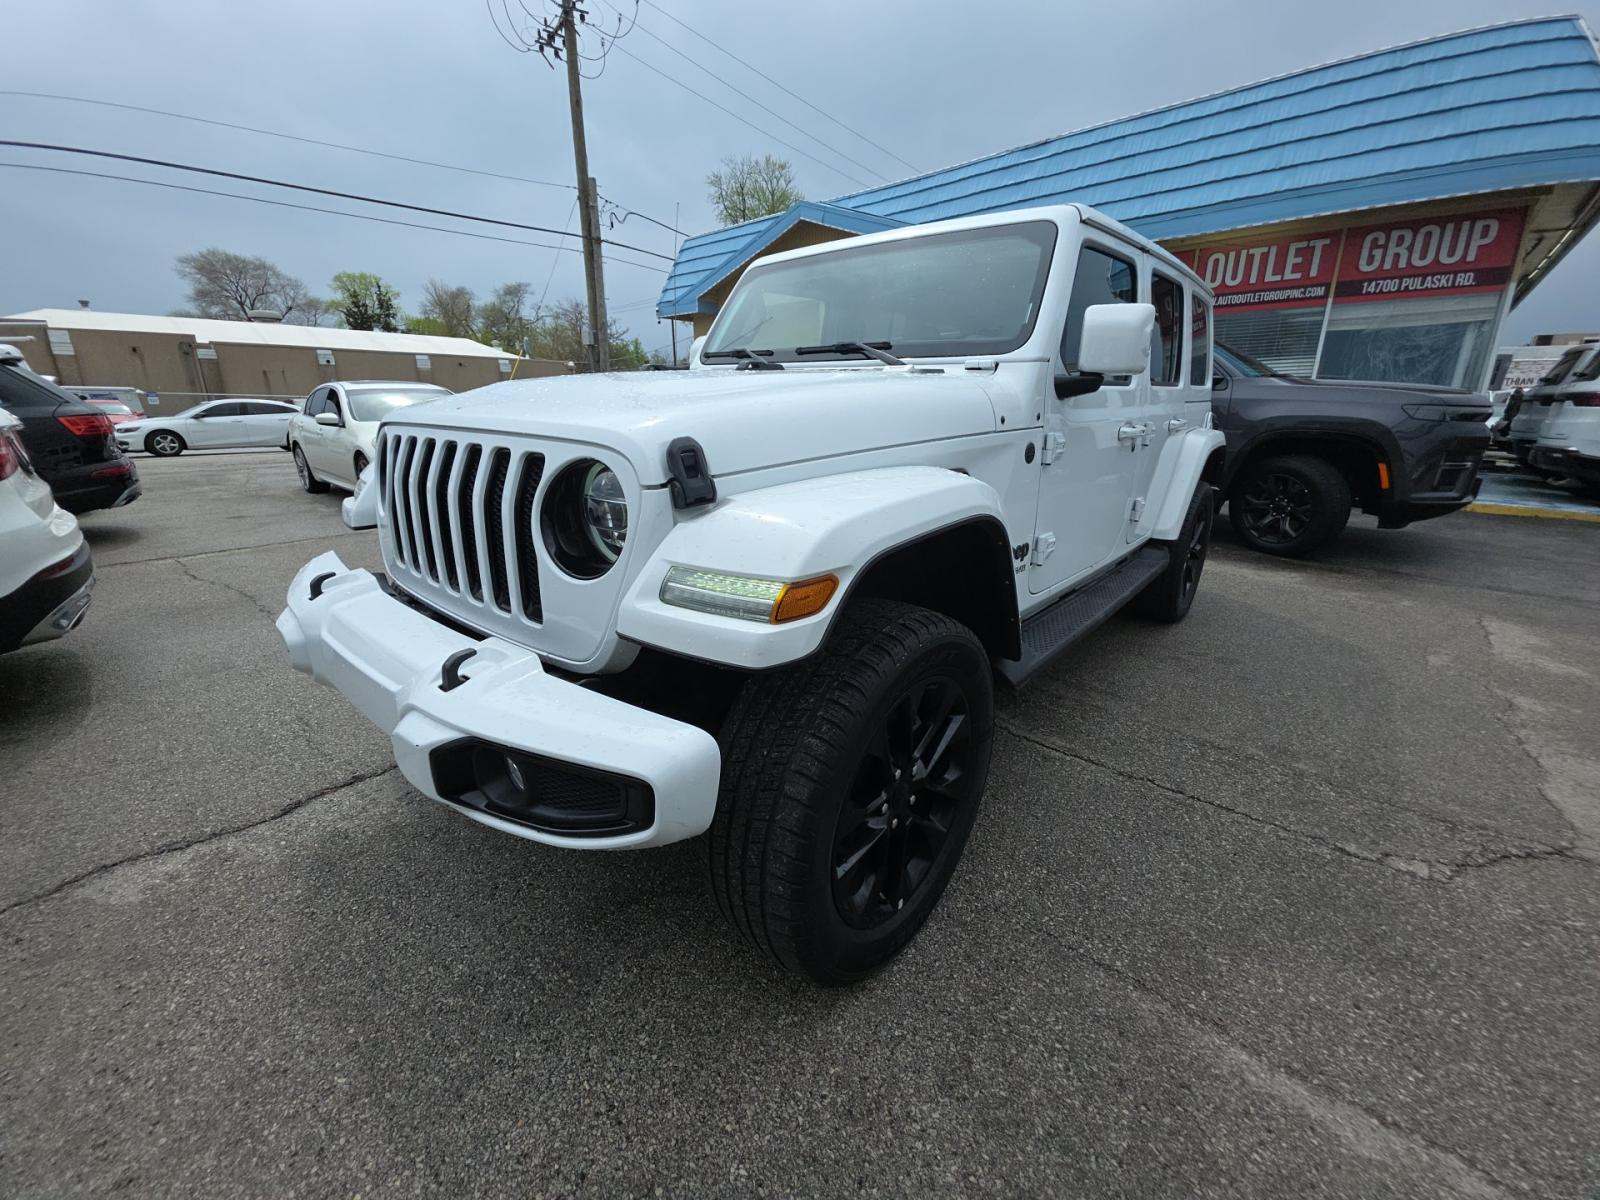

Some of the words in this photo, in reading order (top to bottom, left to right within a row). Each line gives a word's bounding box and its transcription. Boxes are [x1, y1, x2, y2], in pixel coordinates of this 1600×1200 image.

[1204, 238, 1331, 289] OUTLET
[1358, 218, 1499, 272] GROUP
[1362, 279, 1399, 294] 14700
[1400, 273, 1453, 291] PULASKI
[1455, 272, 1476, 286] RD.
